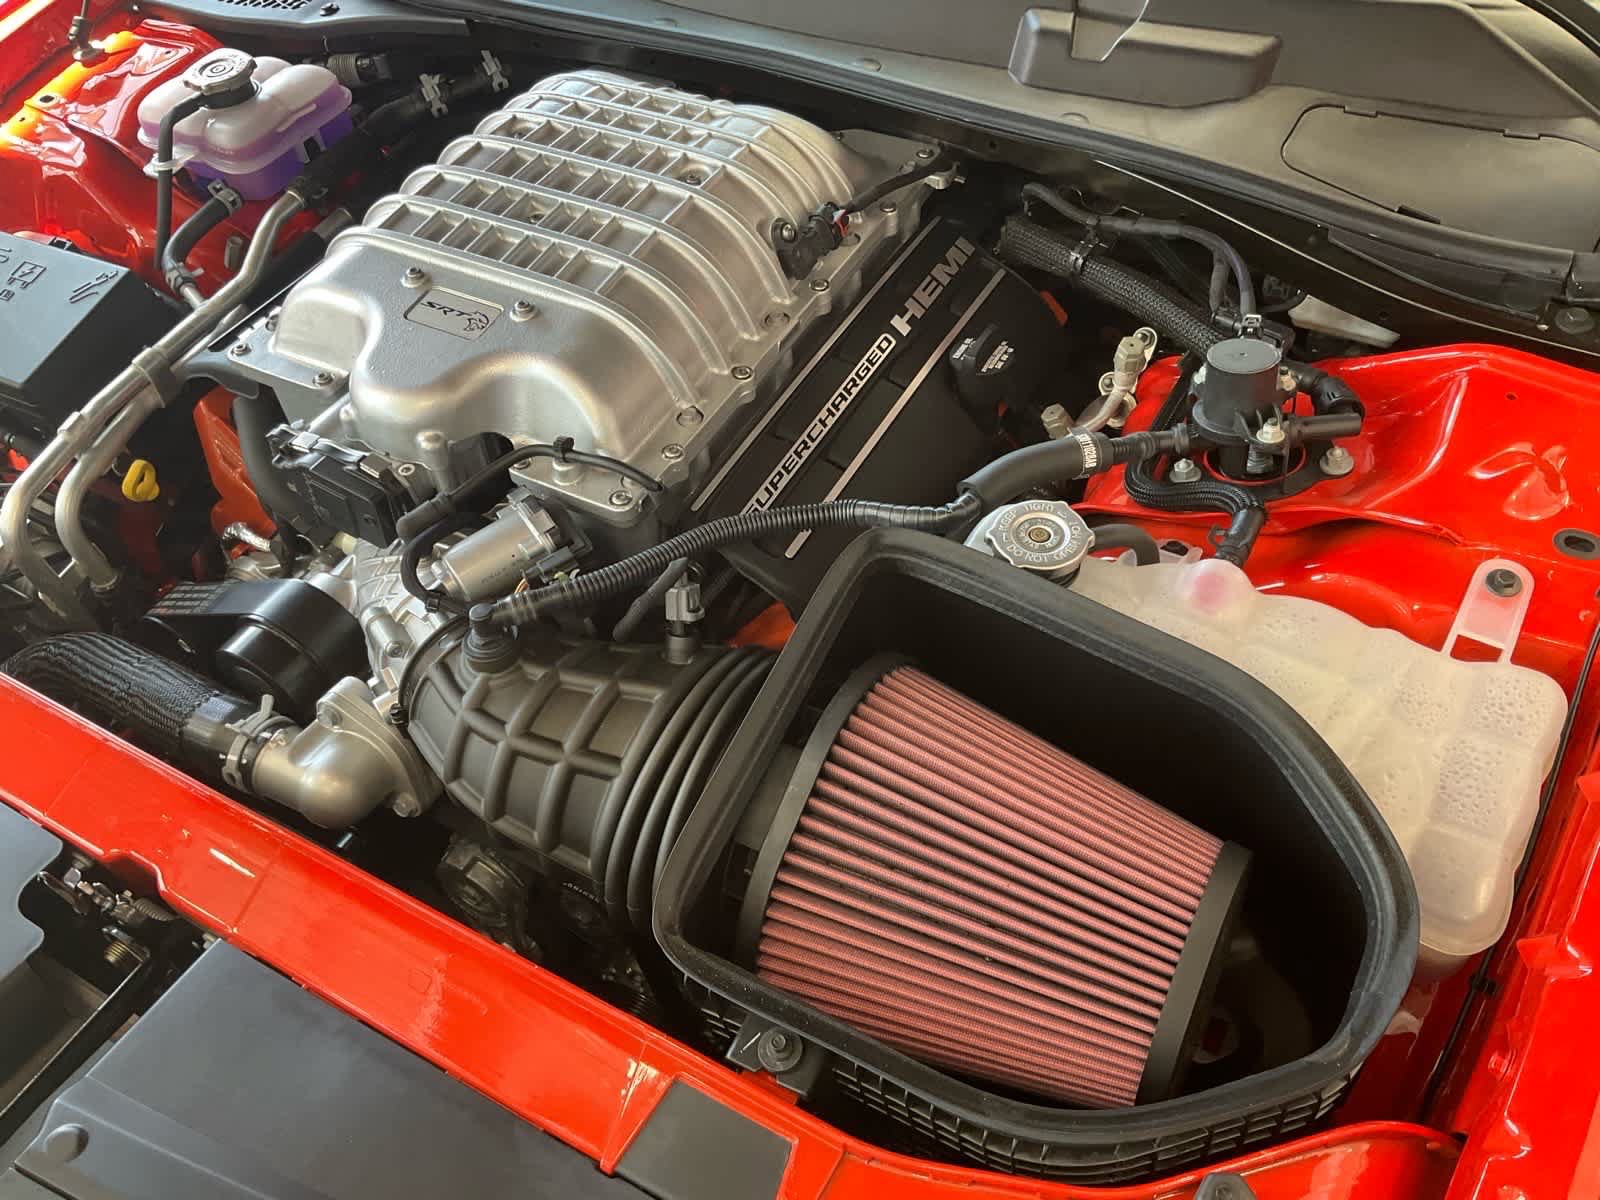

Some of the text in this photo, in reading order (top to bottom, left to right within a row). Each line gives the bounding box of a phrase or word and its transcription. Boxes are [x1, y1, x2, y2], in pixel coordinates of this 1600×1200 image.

[890, 236, 976, 337] HEMI
[420, 301, 472, 317] SRT
[998, 509, 1017, 532] KEEP
[1006, 545, 1024, 557] DO
[1024, 553, 1050, 563] NOT
